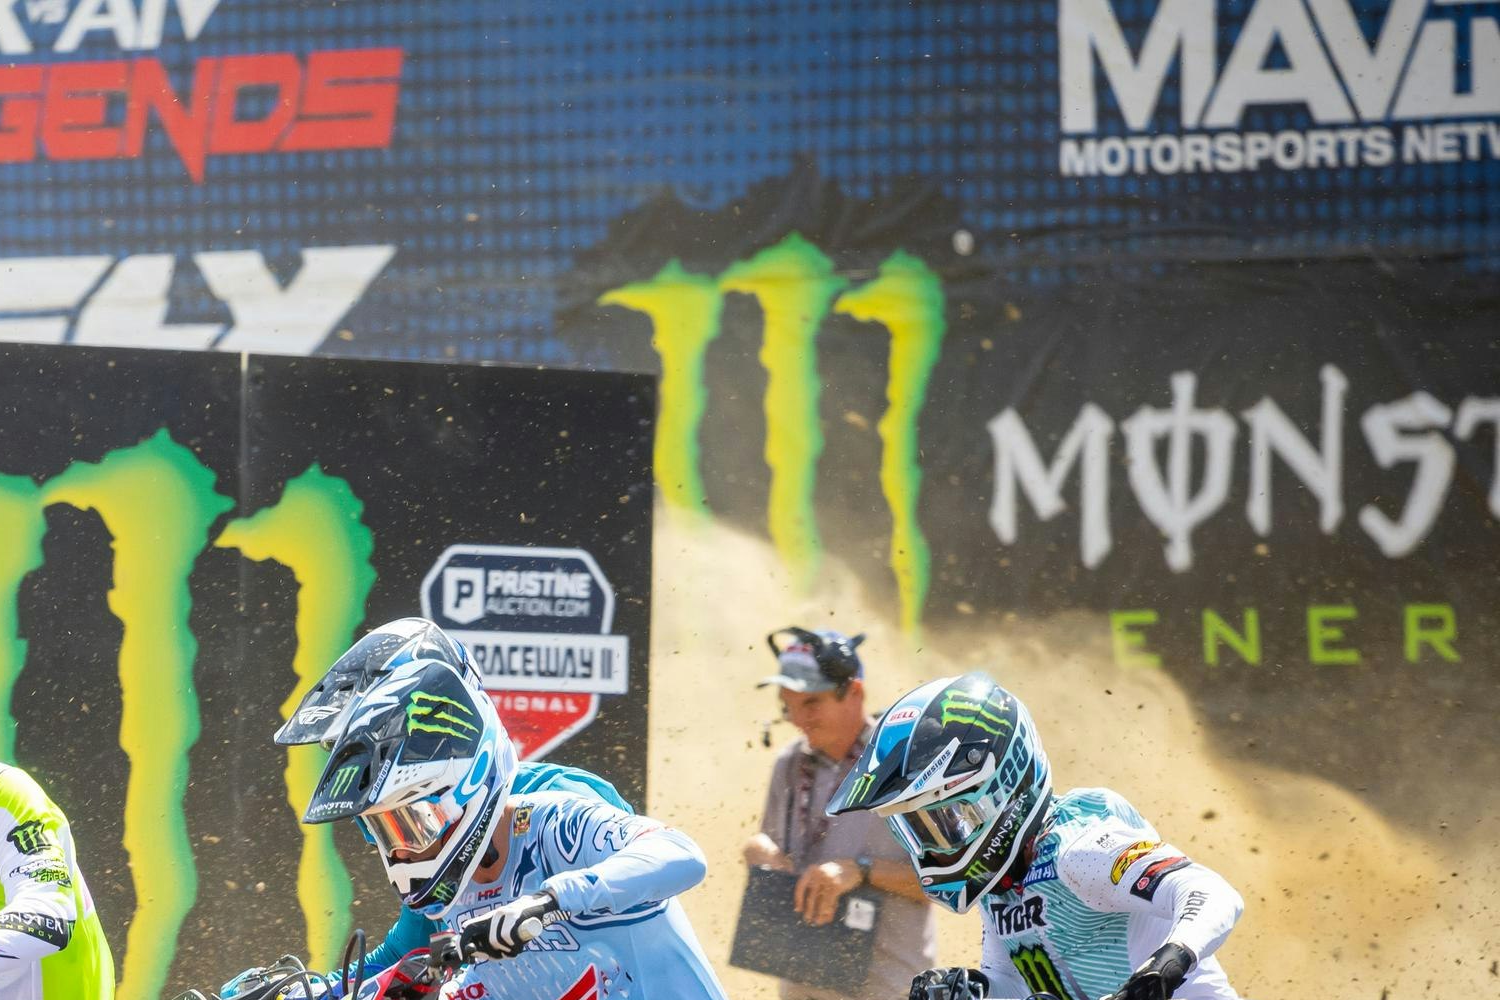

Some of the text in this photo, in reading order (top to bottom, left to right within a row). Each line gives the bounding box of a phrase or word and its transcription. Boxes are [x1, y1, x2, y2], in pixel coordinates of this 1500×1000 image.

[1059, 127, 1394, 177] MOTORSPORTS
[486, 568, 593, 599] PRISTINE
[472, 644, 593, 679] RACEWAY
[1112, 604, 1461, 668] ENER
[460, 806, 494, 864] MONSTER
[983, 793, 1028, 862] MONSTER
